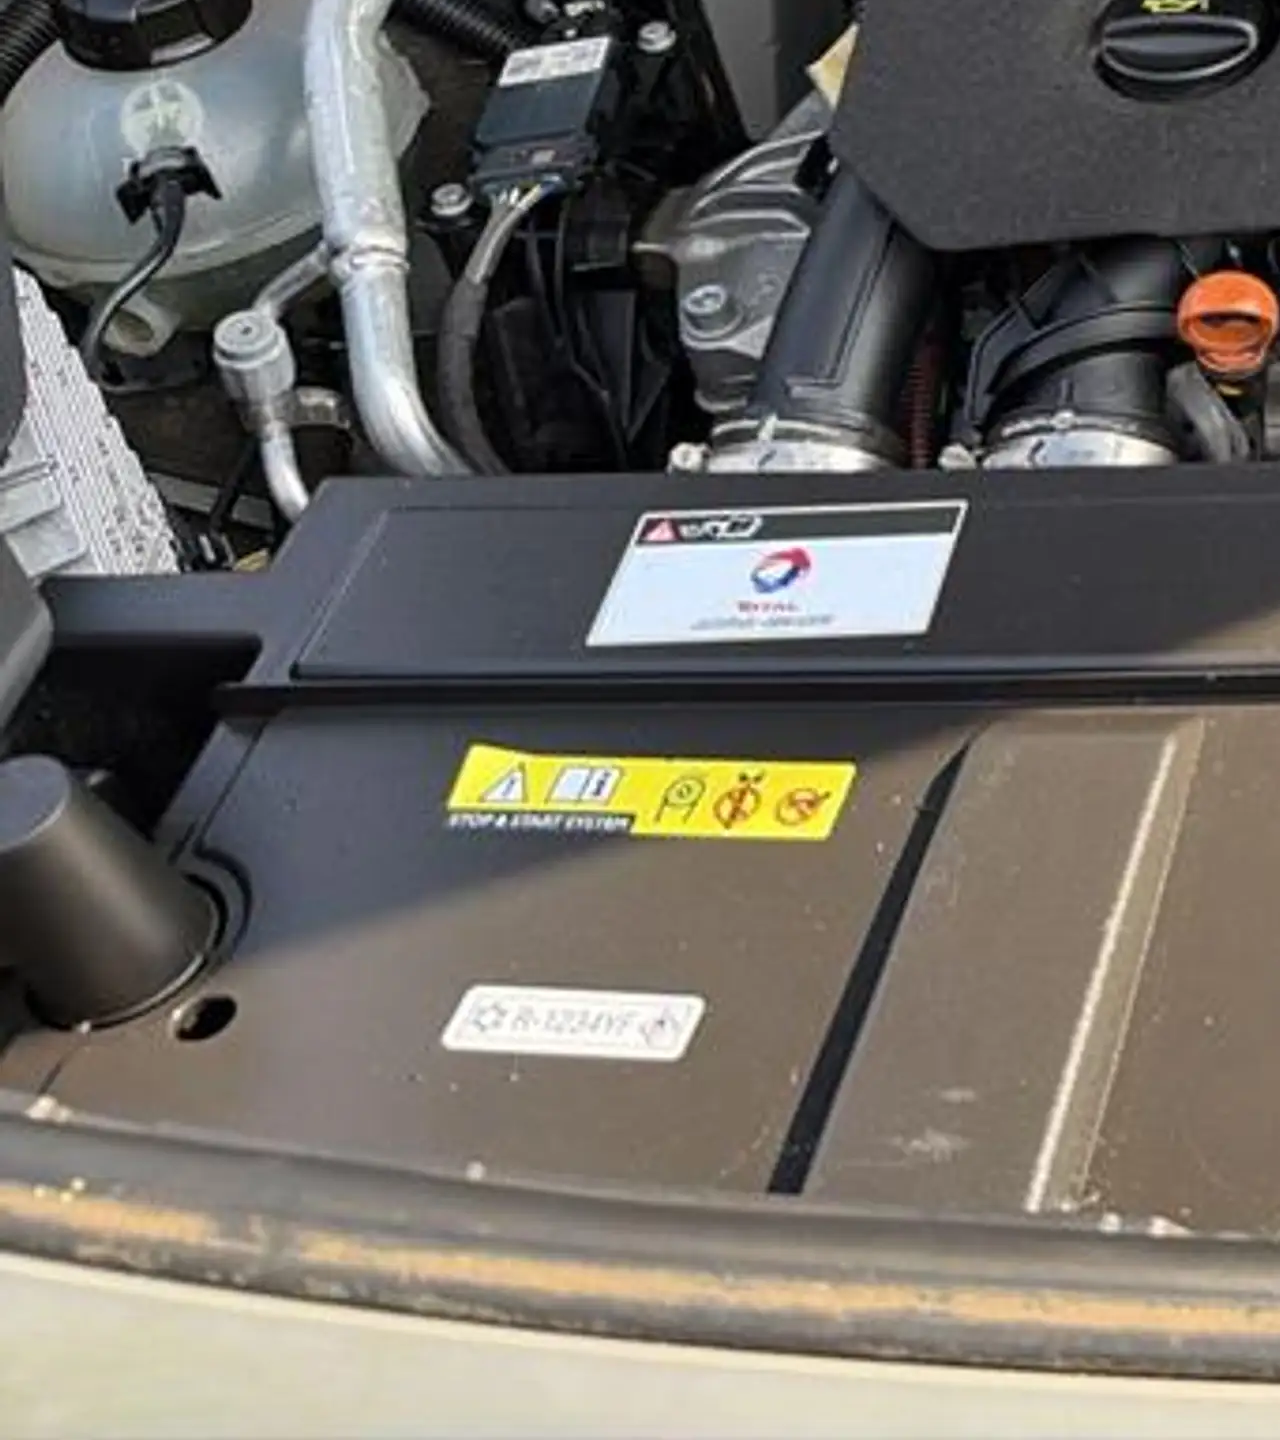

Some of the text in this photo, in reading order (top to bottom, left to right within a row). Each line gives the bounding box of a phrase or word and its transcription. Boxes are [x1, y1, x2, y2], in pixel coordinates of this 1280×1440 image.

[448, 812, 494, 829] STOP
[510, 814, 563, 831] START
[564, 815, 630, 833] SYSTEM
